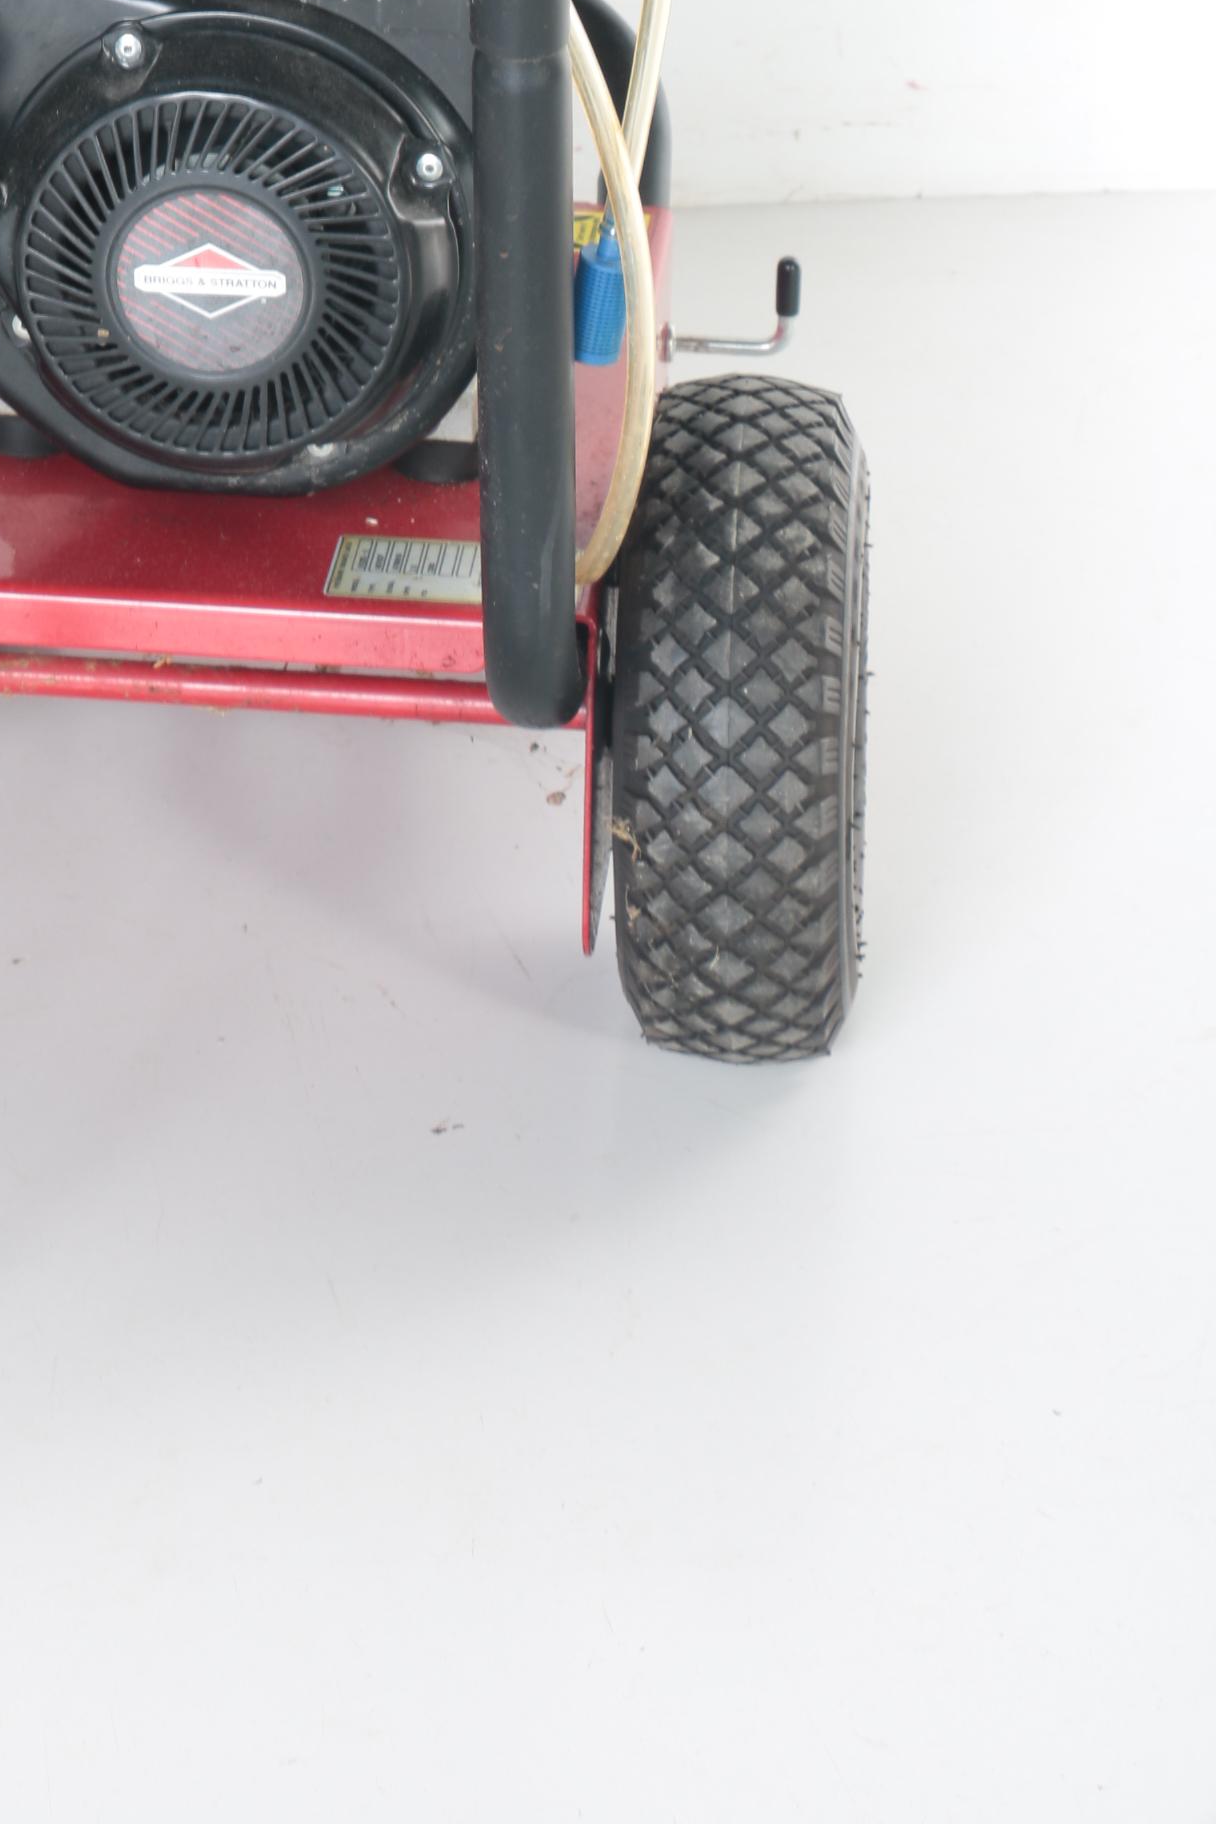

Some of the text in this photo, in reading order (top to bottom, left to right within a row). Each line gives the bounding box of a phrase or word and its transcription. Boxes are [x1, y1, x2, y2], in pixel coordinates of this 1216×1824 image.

[143, 274, 277, 289] BRIGGS & STRATTON
